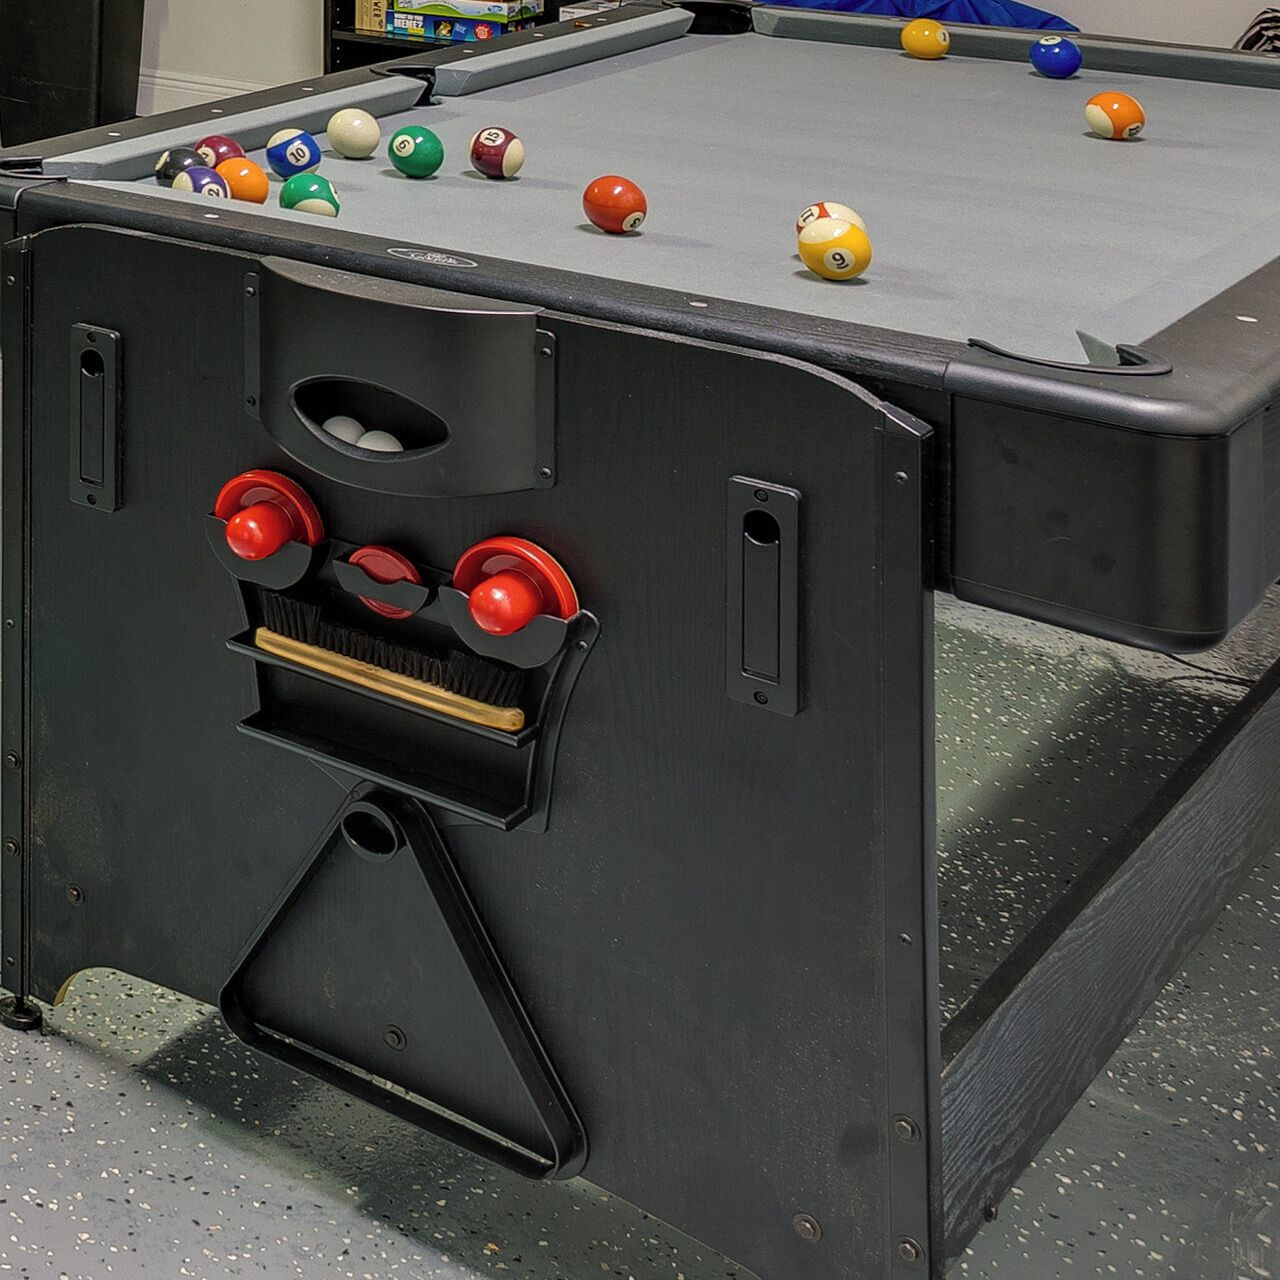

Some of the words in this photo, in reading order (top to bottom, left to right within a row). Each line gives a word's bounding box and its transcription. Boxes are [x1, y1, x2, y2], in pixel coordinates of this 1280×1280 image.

[483, 131, 500, 144] 15
[290, 147, 306, 163] 10
[800, 208, 815, 223] 11
[831, 252, 850, 270] 9
